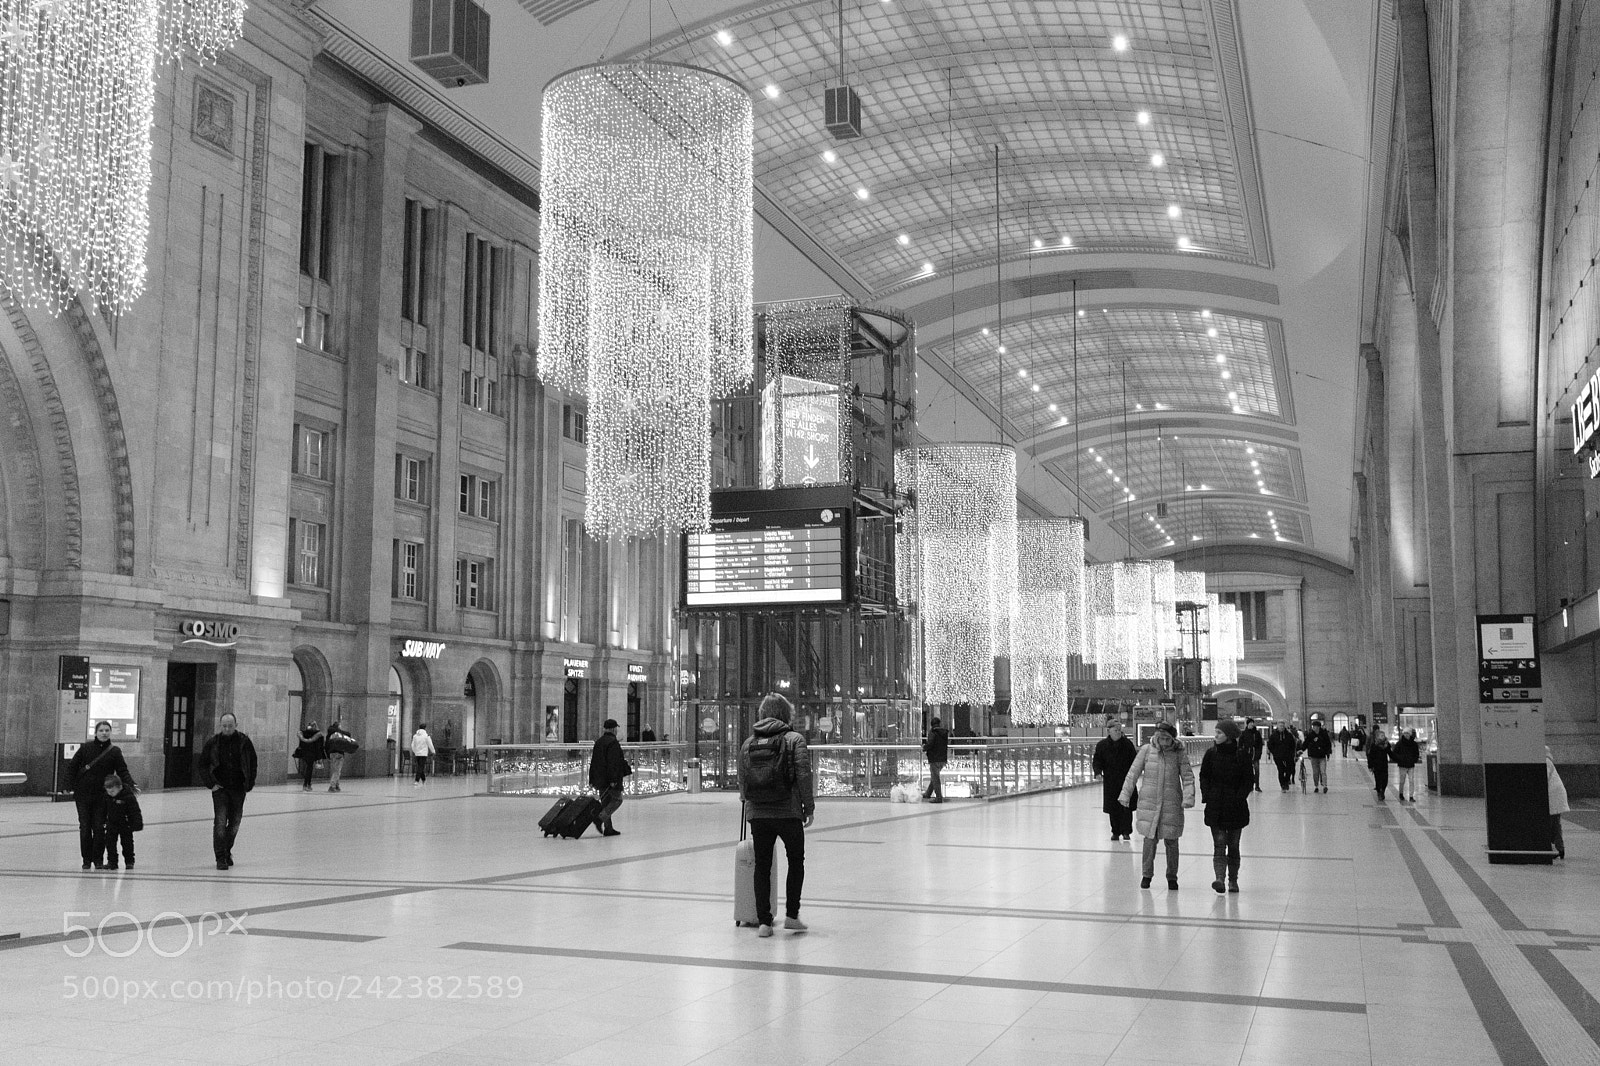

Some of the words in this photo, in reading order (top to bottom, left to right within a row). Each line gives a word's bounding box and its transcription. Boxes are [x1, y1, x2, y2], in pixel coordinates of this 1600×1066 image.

[801, 411, 825, 424] FINDEN
[785, 419, 796, 429] SIE
[797, 420, 818, 432] ALLES
[785, 428, 793, 438] IN
[806, 431, 829, 443] SHOPS
[182, 620, 240, 639] COSMO
[402, 640, 445, 659] SUBWAY
[563, 658, 589, 668] PLAUENER
[567, 669, 585, 678] SPITZE
